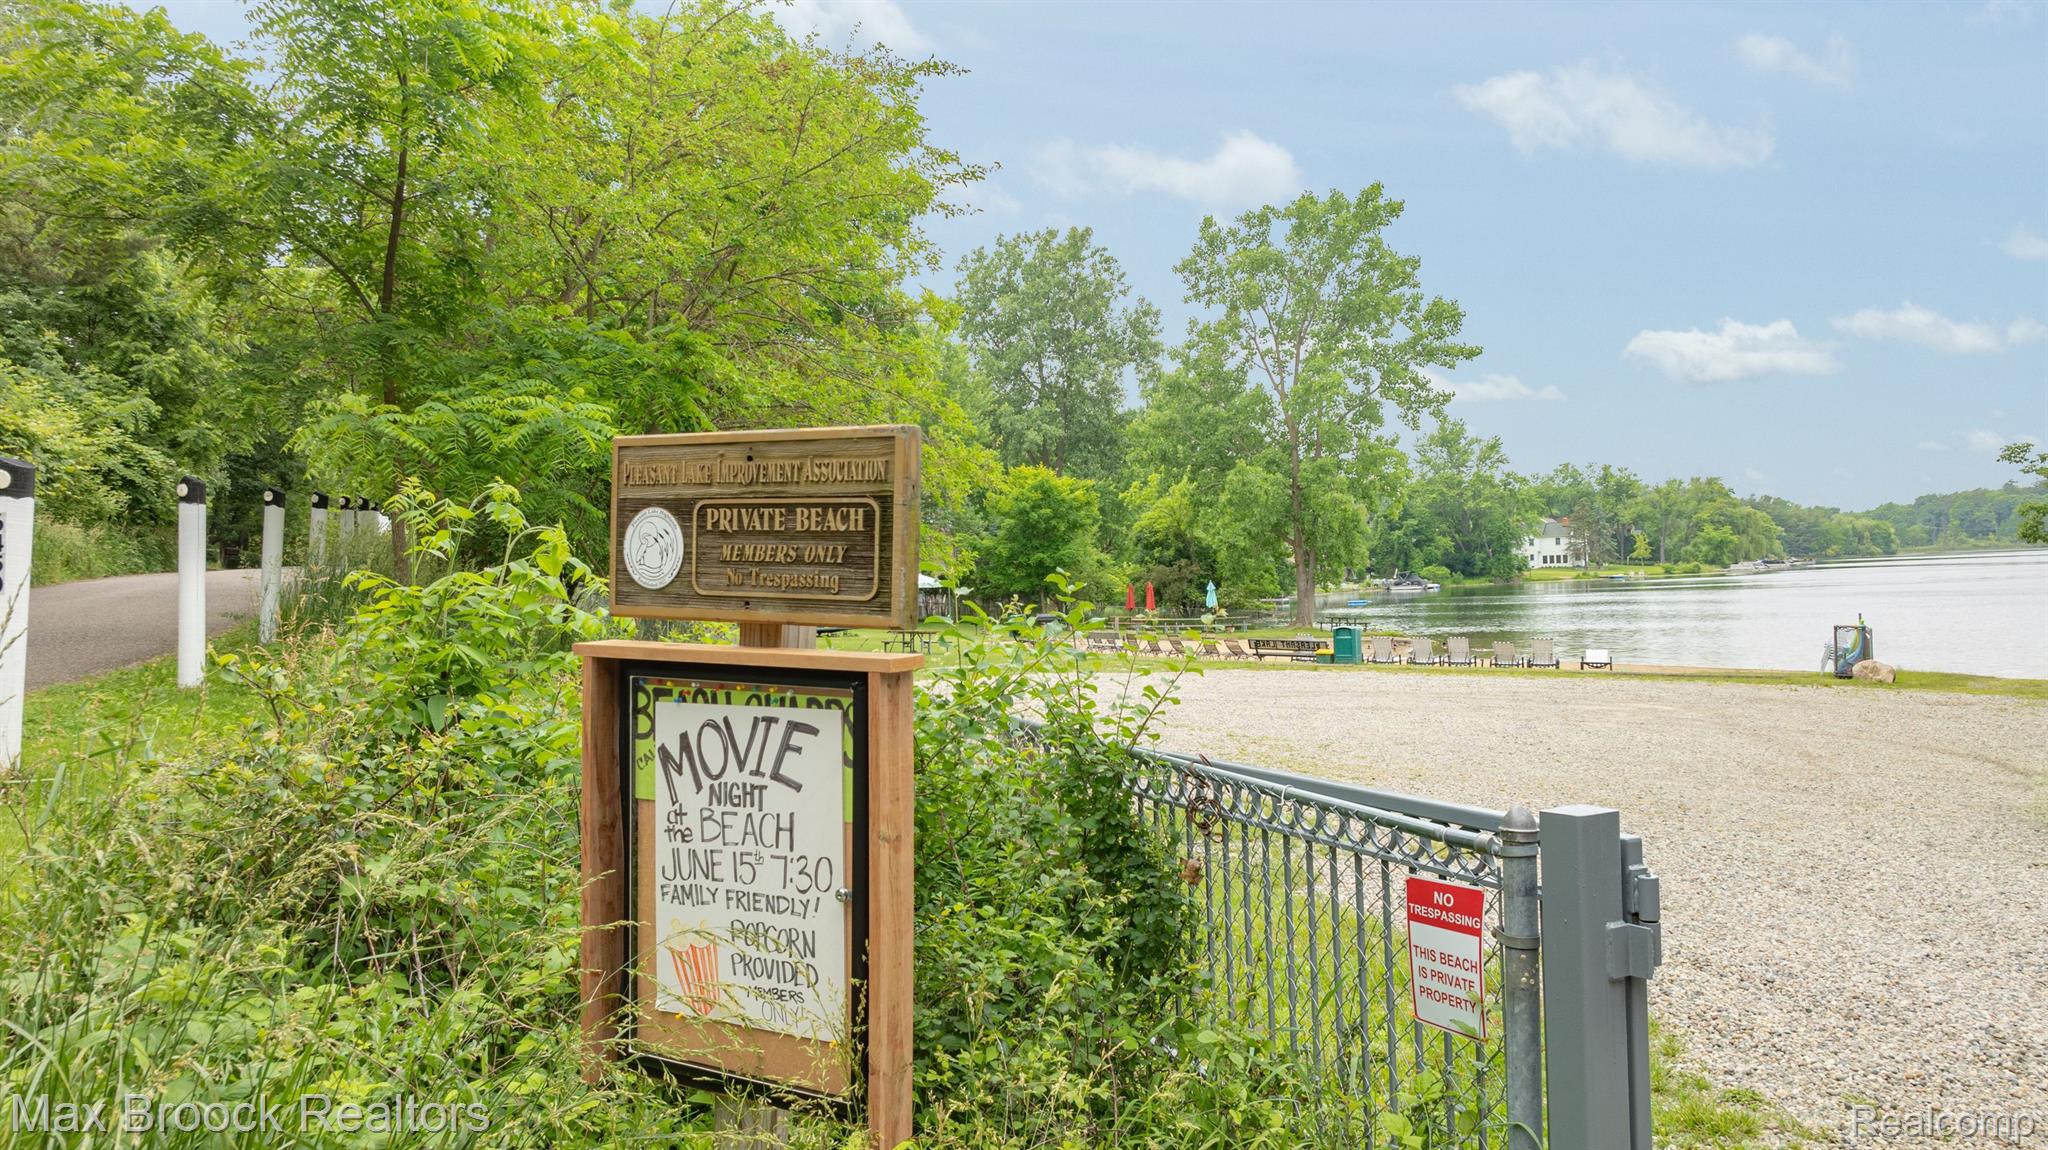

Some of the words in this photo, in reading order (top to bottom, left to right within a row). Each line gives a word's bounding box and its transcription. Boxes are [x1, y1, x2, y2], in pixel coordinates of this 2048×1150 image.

[622, 461, 678, 486] PLEASANT
[681, 459, 712, 485] LAKE
[717, 457, 801, 485] IMPROVEMENT
[804, 456, 889, 483] ASSOCIATION
[706, 507, 786, 533] PRIVATE
[795, 507, 866, 532] BEACH
[720, 544, 797, 563] MEMBERS
[804, 544, 849, 564] ONLY
[726, 568, 743, 586] No
[749, 569, 840, 594] Trespassing
[657, 715, 820, 805] MOVIE
[708, 782, 768, 812] NIGHT
[667, 803, 688, 826] at
[664, 822, 694, 844] the
[700, 807, 795, 852] BEACH
[661, 848, 724, 884] JUNE
[770, 854, 833, 894] 7:30
[660, 883, 719, 907] FAMILY
[726, 889, 821, 920] FRIENDLY!
[1433, 891, 1454, 907] NO
[1408, 902, 1481, 929] TRESPASSING
[730, 919, 816, 959] POPCORN
[730, 953, 819, 989] PROVIDED
[1413, 945, 1437, 963] THIS
[1440, 951, 1478, 974] BEACH
[1418, 965, 1428, 979] IS
[1431, 971, 1475, 992] PRIVATE
[747, 985, 805, 1004] MEMBERS
[1419, 986, 1477, 1014] PROPERTY
